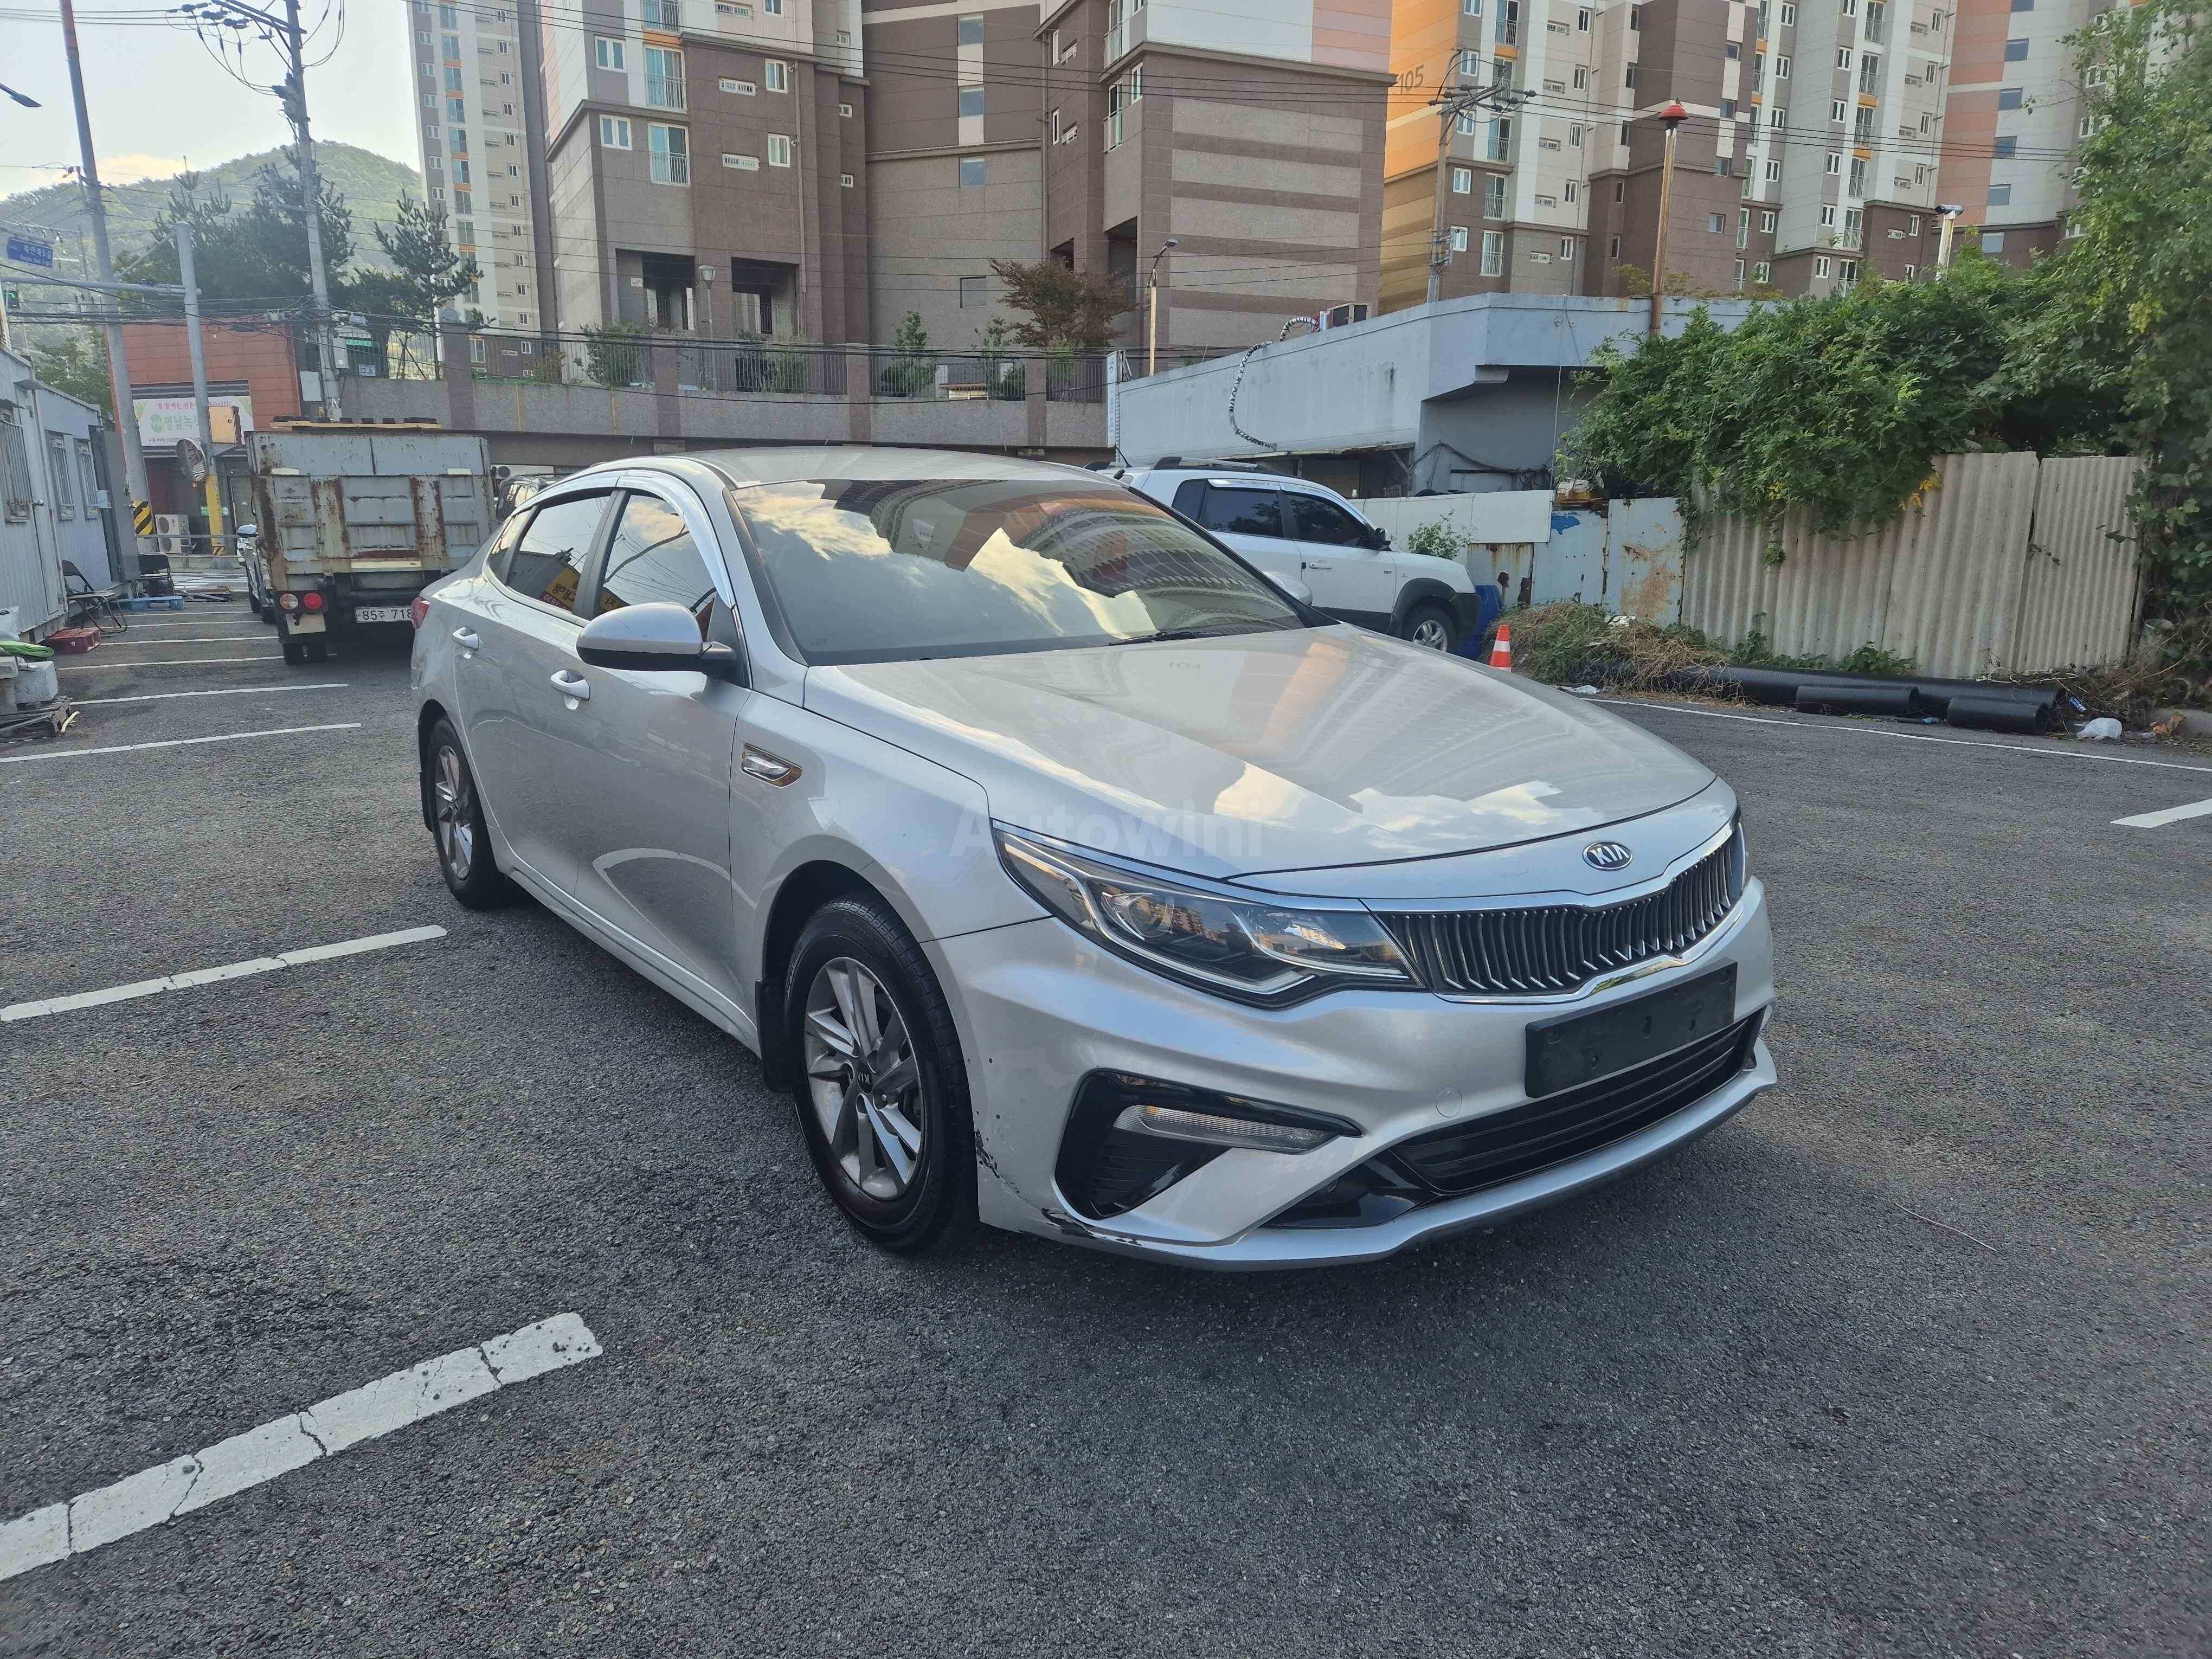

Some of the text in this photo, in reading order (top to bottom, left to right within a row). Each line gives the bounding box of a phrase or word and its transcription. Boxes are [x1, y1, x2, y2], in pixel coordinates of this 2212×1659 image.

[1399, 64, 1424, 95] 105
[391, 608, 412, 619] 718
[1589, 844, 1629, 865] KIA
